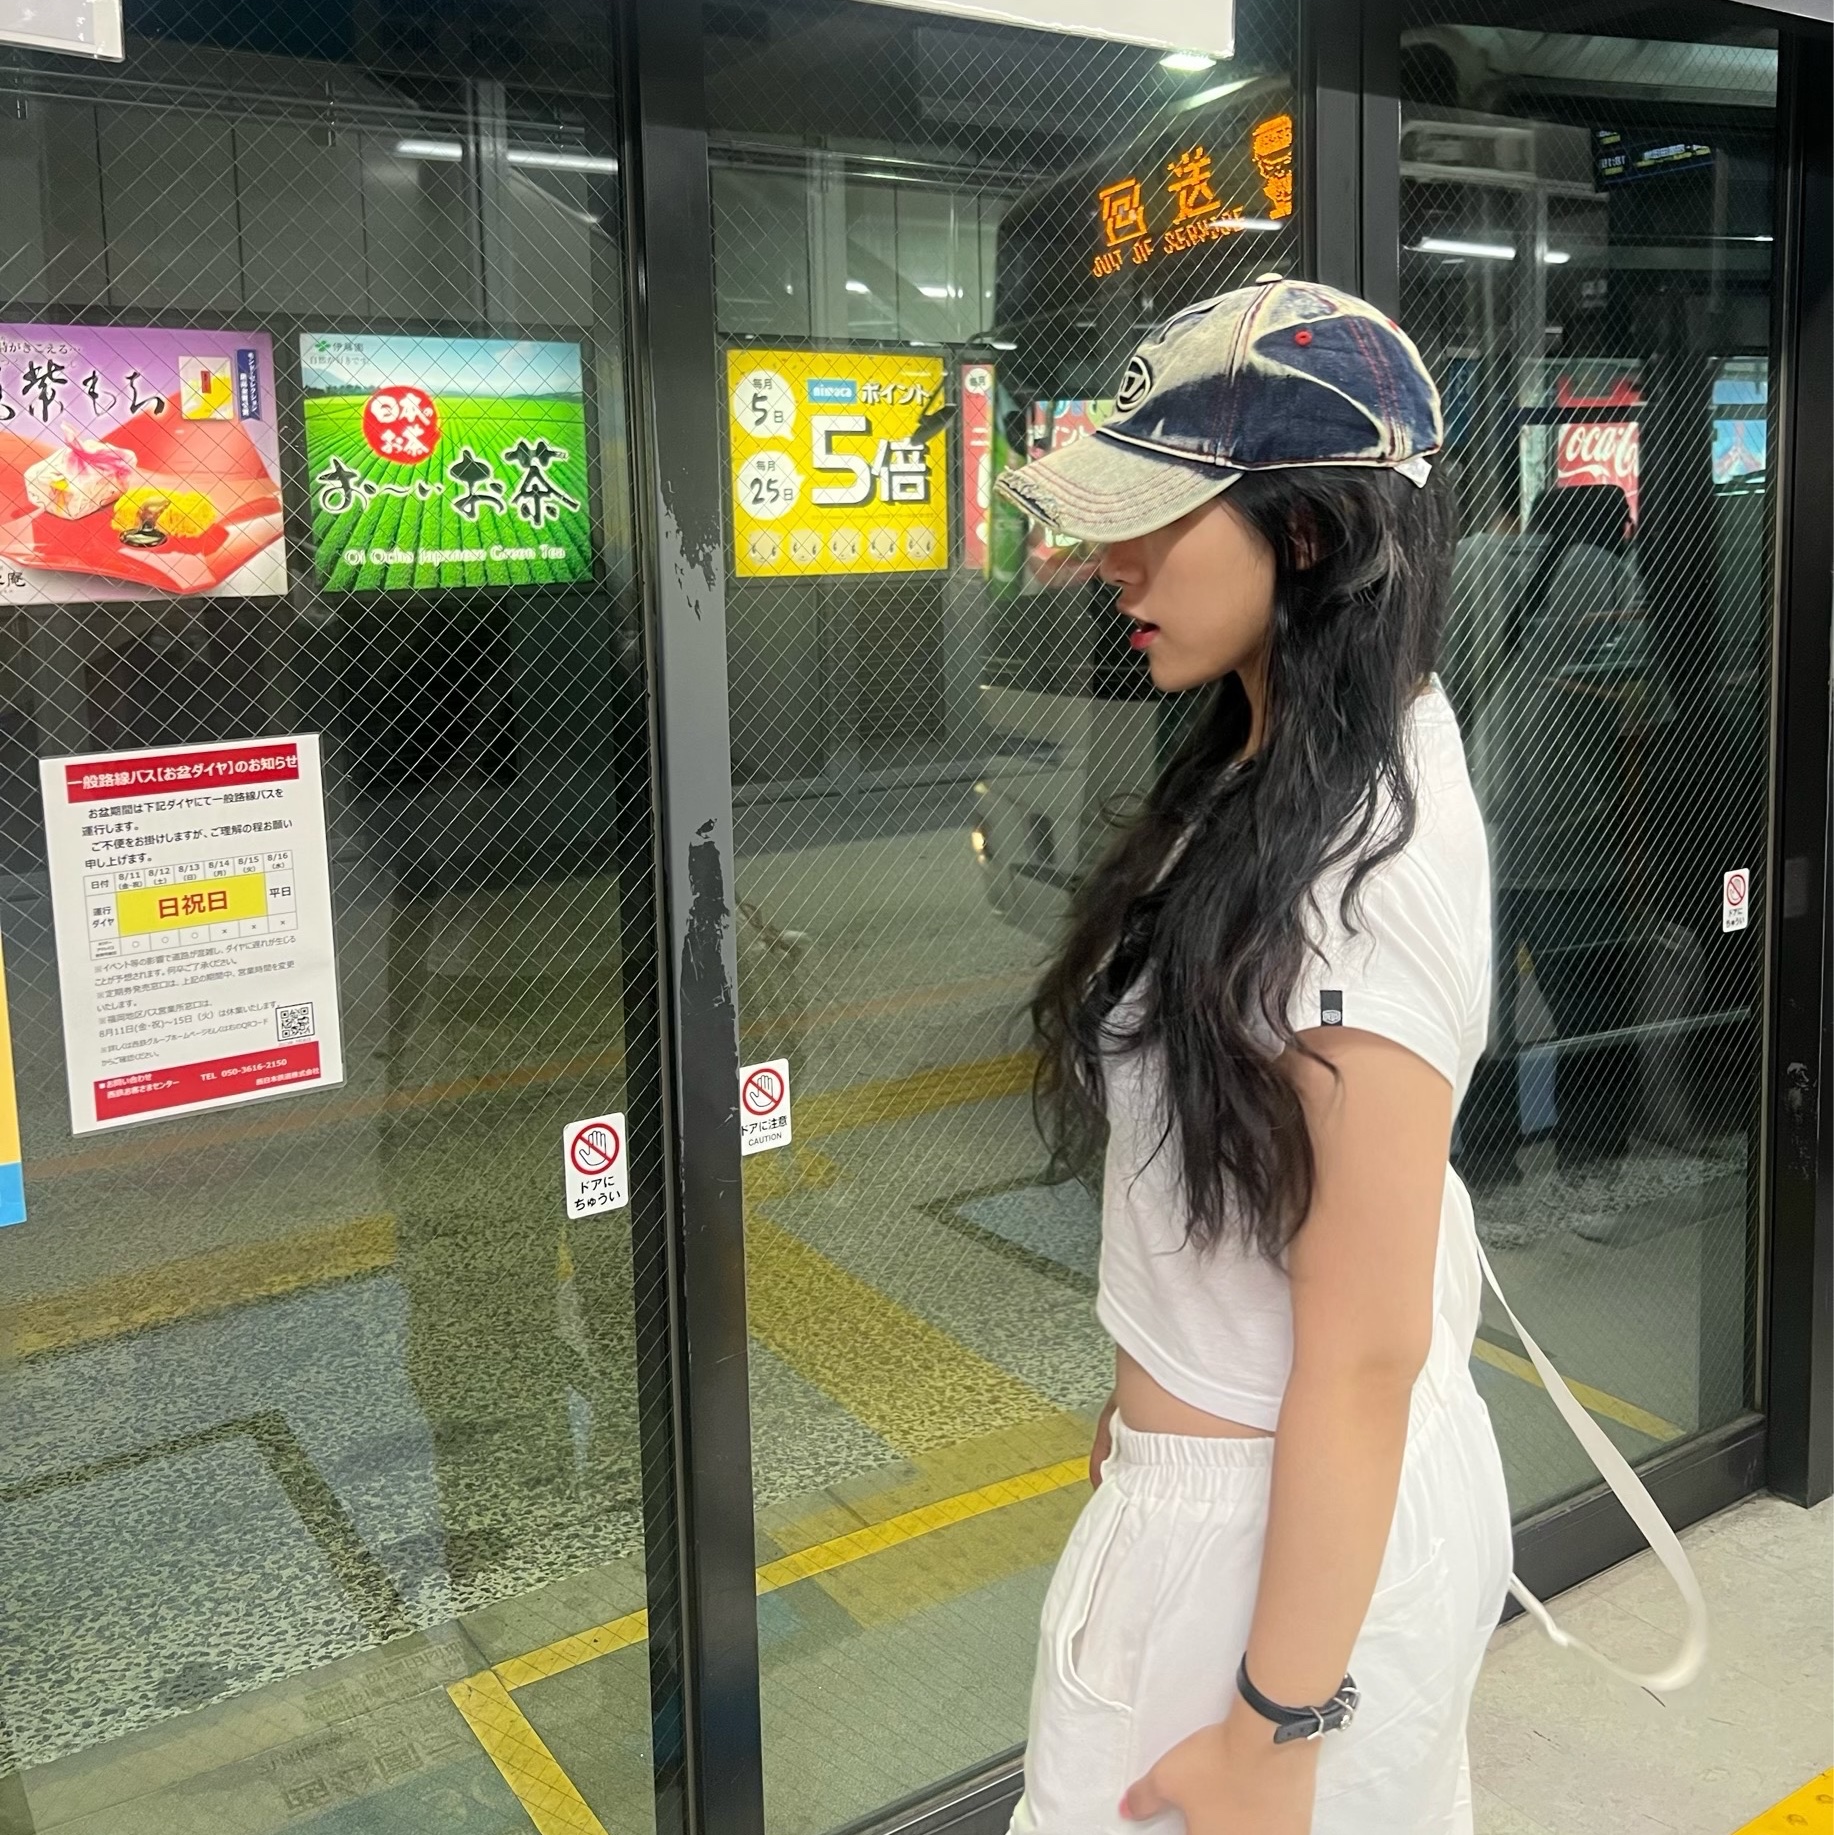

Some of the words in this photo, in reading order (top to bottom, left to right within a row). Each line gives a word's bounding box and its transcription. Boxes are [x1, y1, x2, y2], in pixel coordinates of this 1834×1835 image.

[1098, 146, 1222, 247] 回送
[1092, 248, 1123, 278] OUT
[1131, 237, 1154, 265] OF
[0, 358, 166, 423] 紫もち
[752, 377, 773, 391] 毎月
[860, 382, 931, 406] ポイント
[756, 460, 776, 472] 毎月
[810, 414, 932, 506] 5倍
[750, 476, 794, 505] 25日
[67, 755, 298, 790] 一般路線バス【お盆ダイヤ】のお知らせ
[88, 789, 284, 819] お盆期間は下記ダイヤにて一般路線バスを
[81, 821, 141, 838] 運行します。
[91, 819, 293, 853] ご不便をお掛けしますが、ご理解の程お願い
[85, 853, 153, 870] 申し上げます。
[208, 859, 230, 869] 8/14
[238, 856, 260, 866] 8/15
[267, 852, 289, 862] 8/16
[118, 872, 141, 882] 8/11
[148, 867, 170, 877] 8/12
[178, 863, 201, 873] 8/13
[91, 879, 110, 891] 日付
[268, 886, 292, 899] 平日
[158, 890, 228, 920] 日祝日
[91, 917, 115, 928] ダイヤ
[201, 1073, 217, 1082] TEL
[221, 1058, 288, 1078] 050-3616-2150
[741, 1114, 788, 1137] ドアに注意
[748, 1131, 782, 1147] CAUTION
[580, 1175, 615, 1195] ドアに
[574, 1192, 621, 1212] ちゅうい
